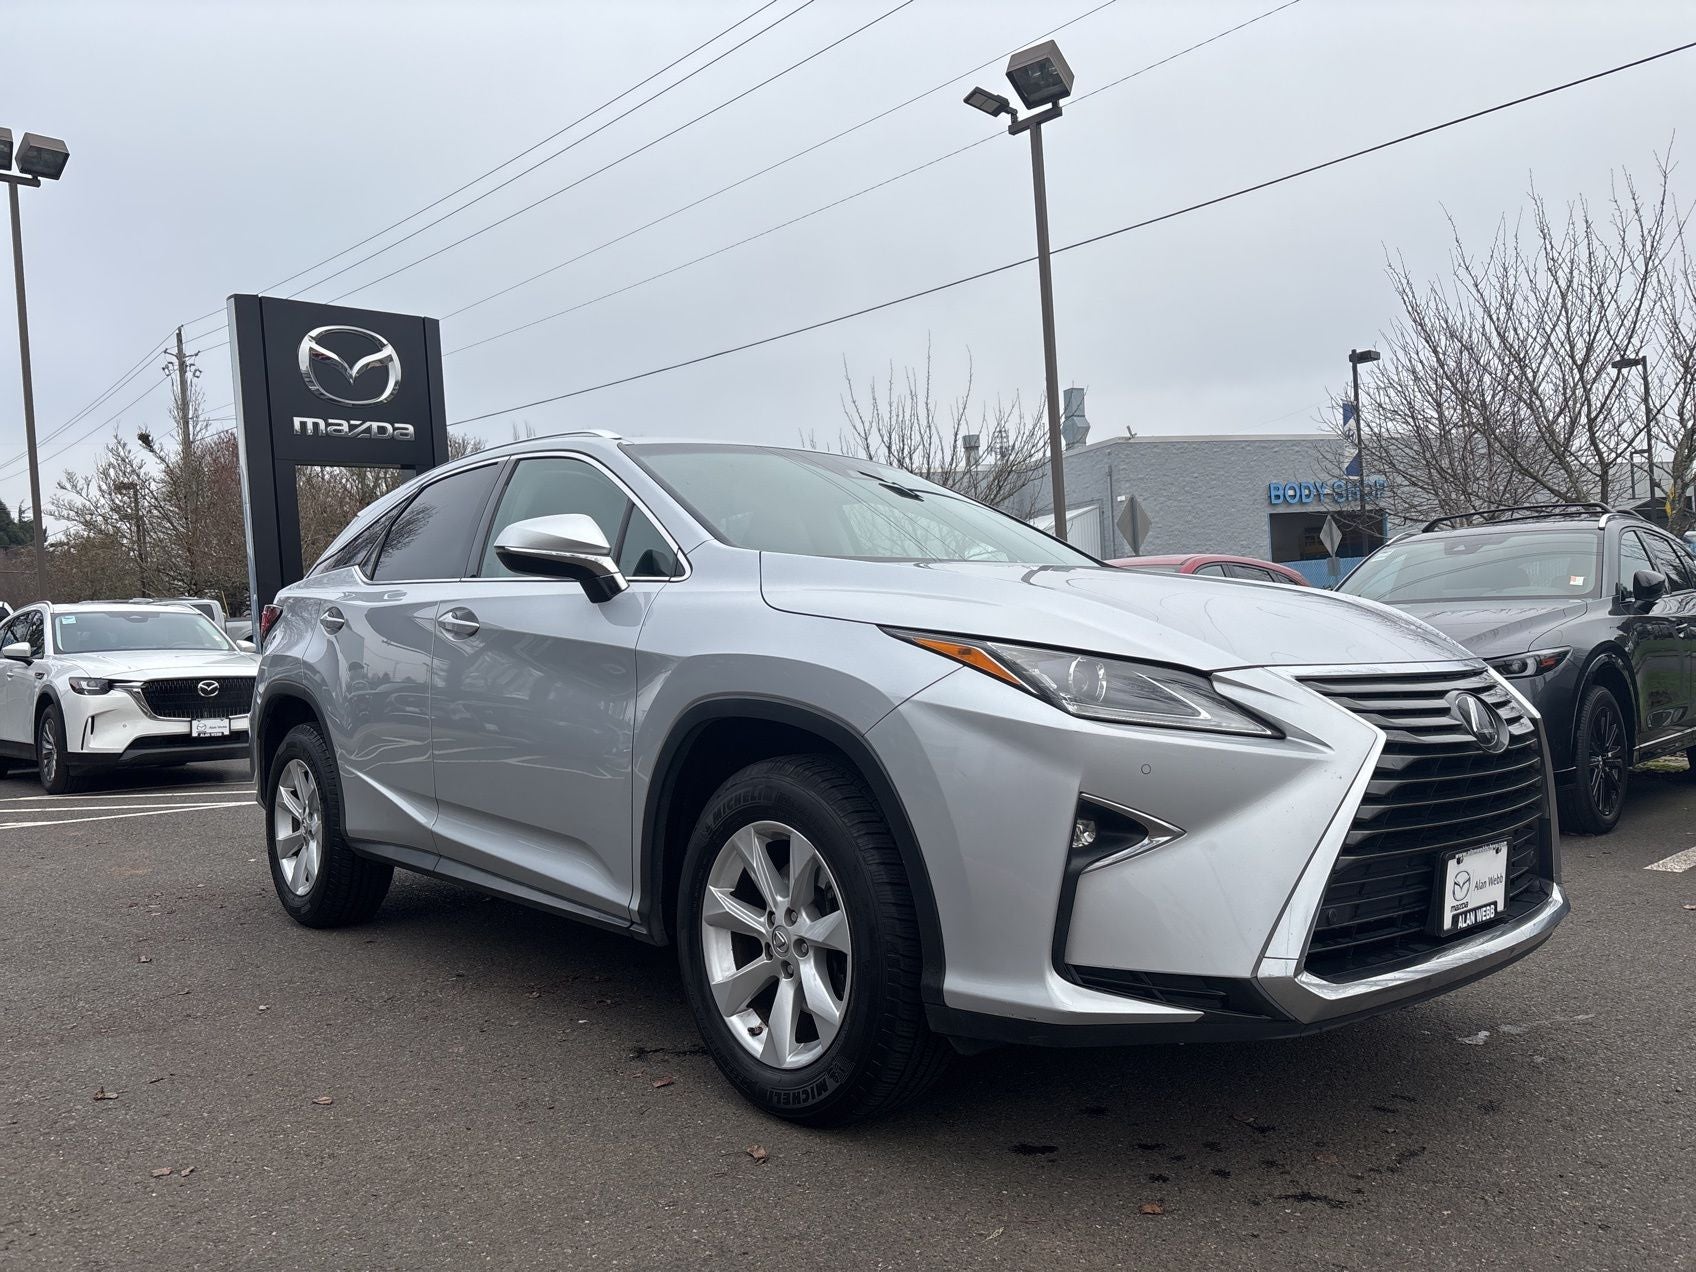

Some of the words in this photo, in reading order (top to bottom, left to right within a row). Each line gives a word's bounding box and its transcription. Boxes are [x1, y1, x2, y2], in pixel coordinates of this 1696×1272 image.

[1269, 481, 1327, 504] BODY
[1473, 881, 1488, 892] Alan
[1487, 874, 1504, 888] Webb
[1457, 909, 1476, 930] ALAN
[1476, 904, 1495, 922] WEBB
[764, 1077, 829, 1105] MICHELI
